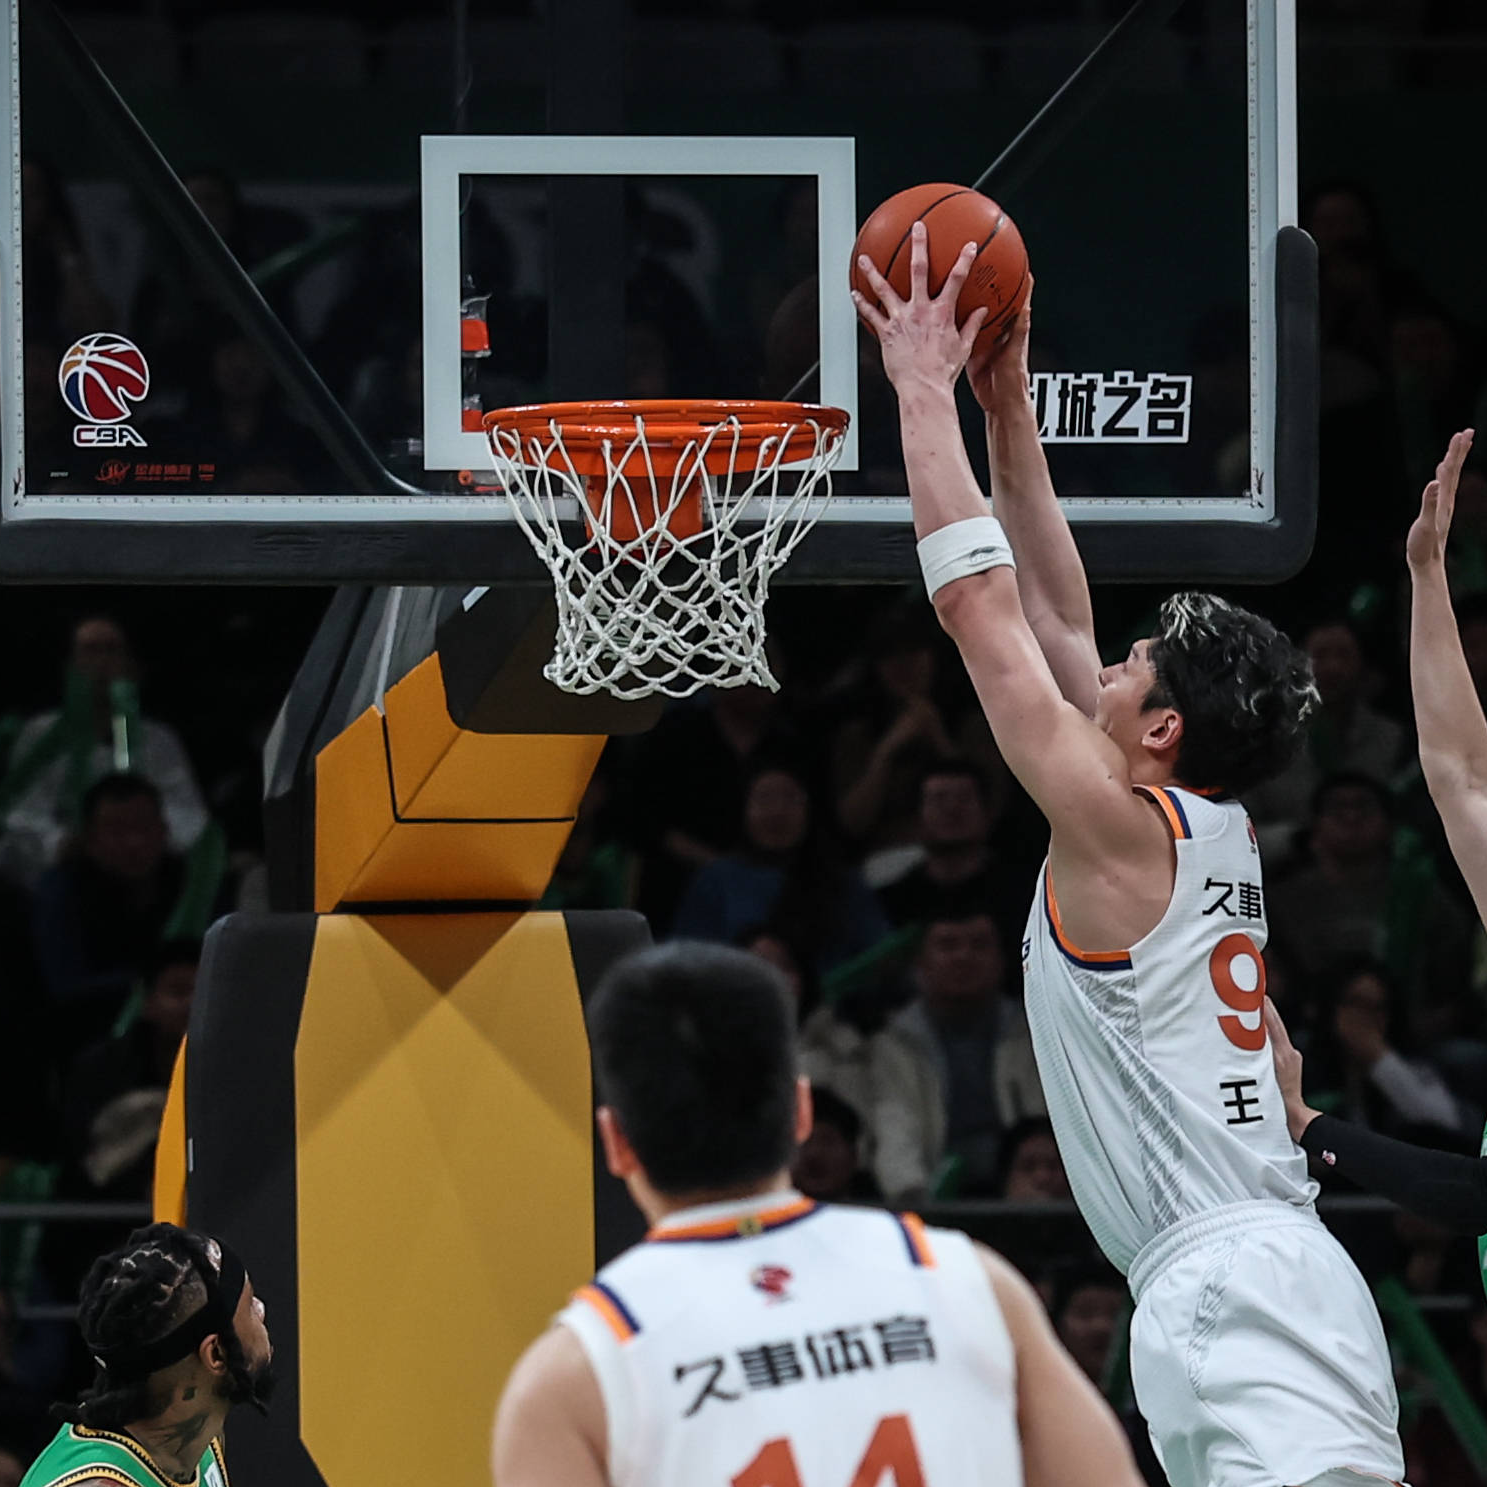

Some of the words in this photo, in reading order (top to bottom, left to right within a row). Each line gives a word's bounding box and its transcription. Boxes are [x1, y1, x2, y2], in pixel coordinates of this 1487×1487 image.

[74, 425, 148, 447] CBA
[1209, 932, 1267, 1051] 9
[1219, 1079, 1264, 1125] 王
[673, 1315, 938, 1418] 久事体育
